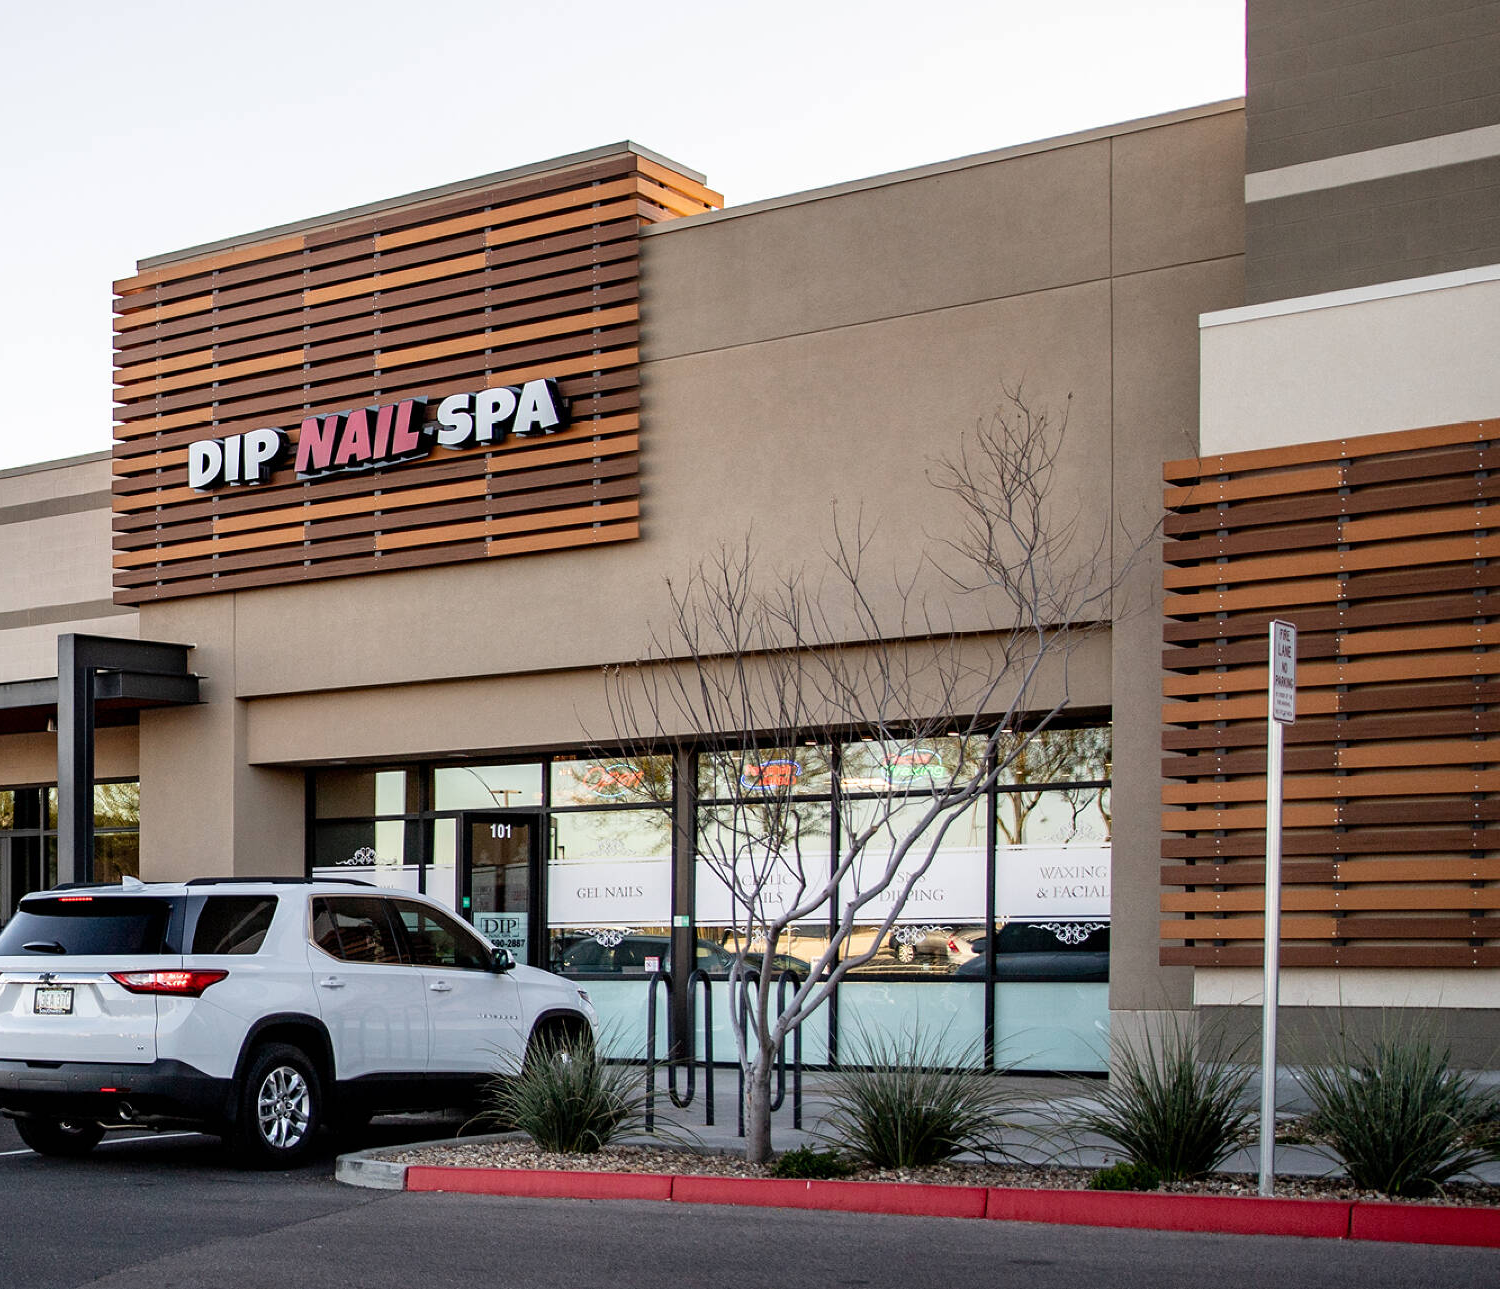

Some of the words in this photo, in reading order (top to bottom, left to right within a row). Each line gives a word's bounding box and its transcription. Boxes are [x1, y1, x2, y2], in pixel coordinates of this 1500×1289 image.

[188, 427, 283, 490] DIP
[295, 398, 422, 475] NAIL
[436, 378, 562, 447] SPA
[1278, 643, 1292, 658] LANE
[1281, 662, 1288, 673] NO
[1275, 675, 1293, 689] PARKING
[490, 823, 511, 839] 101
[1040, 866, 1107, 879] WAXING
[577, 887, 601, 899] GEL
[605, 886, 644, 898] NAILS
[880, 889, 944, 902] DIPING
[1037, 887, 1048, 899] &
[1053, 885, 1110, 898] FACIAL
[485, 919, 517, 933] DIP
